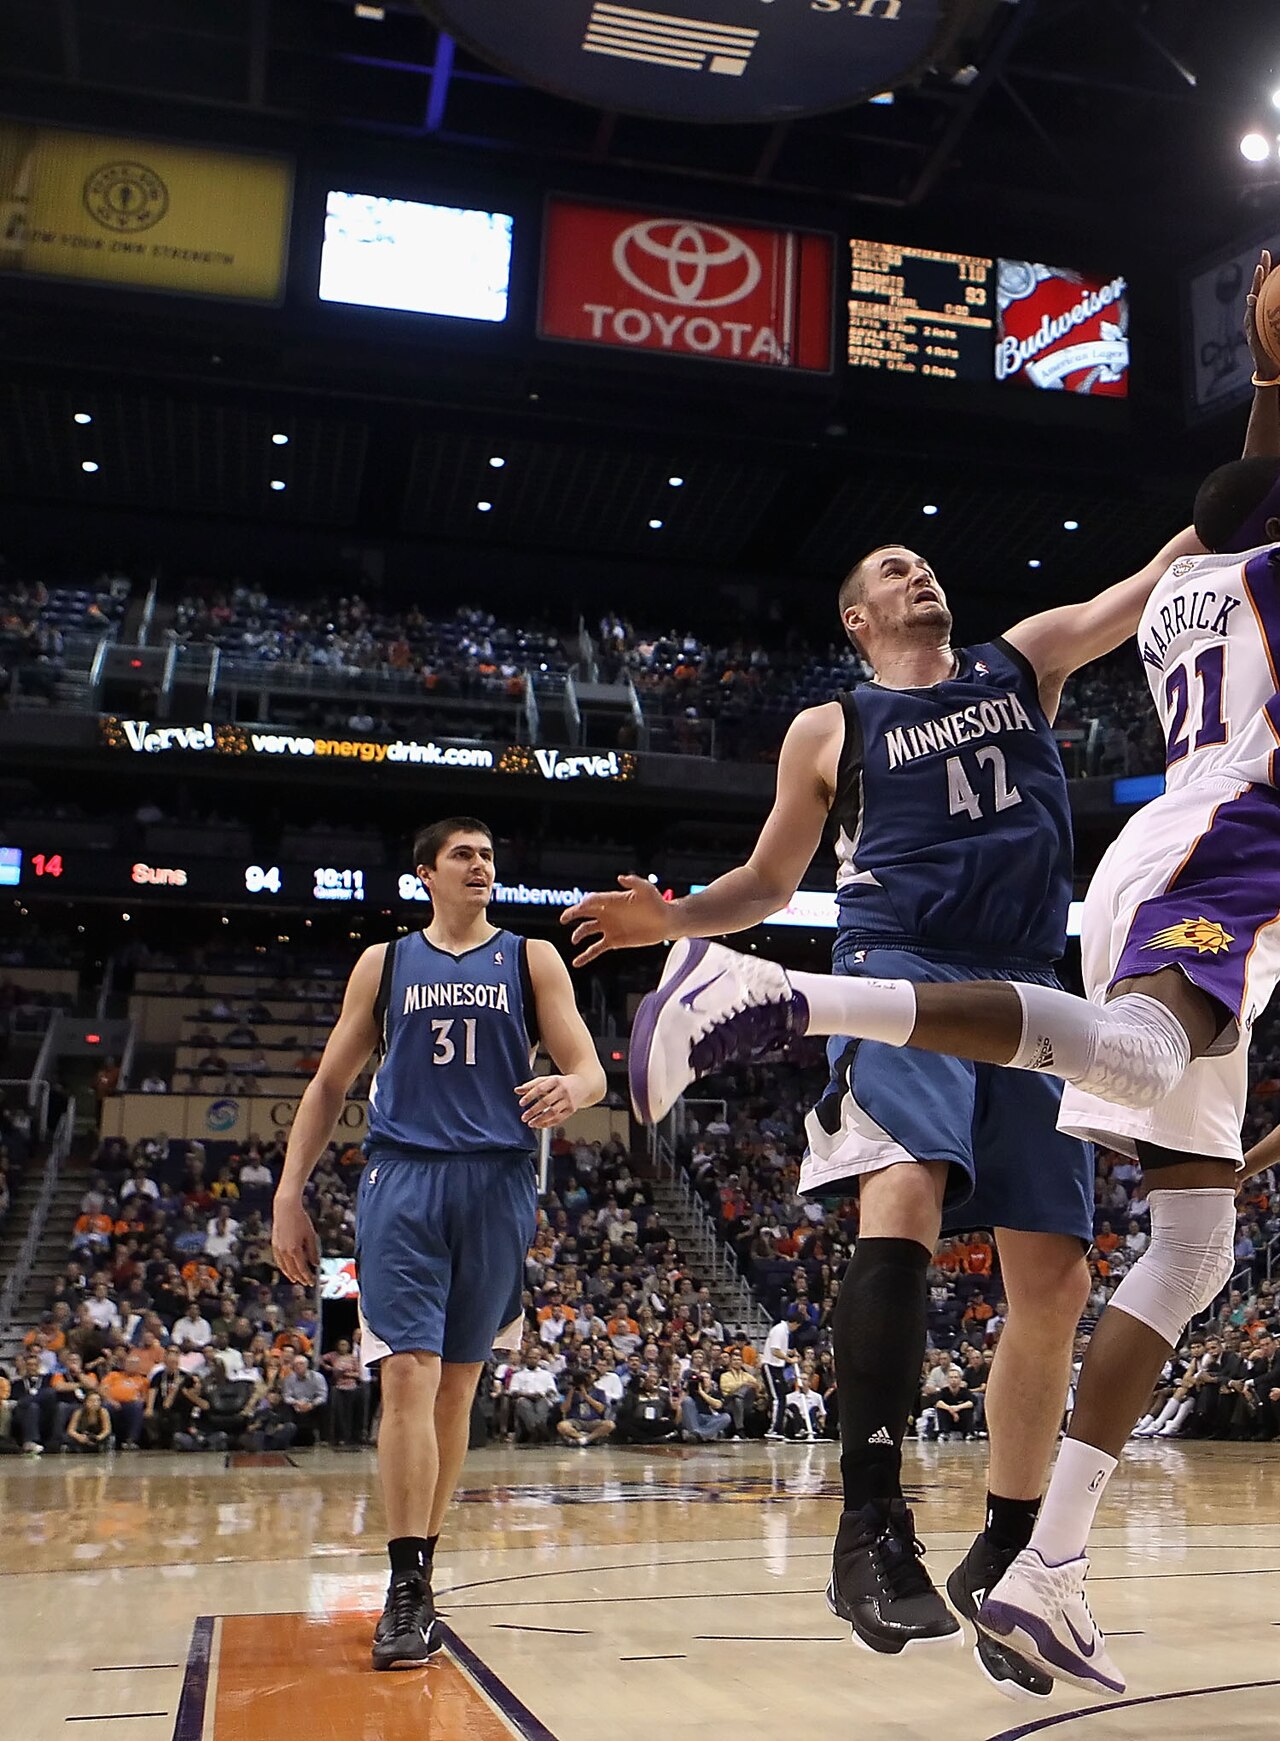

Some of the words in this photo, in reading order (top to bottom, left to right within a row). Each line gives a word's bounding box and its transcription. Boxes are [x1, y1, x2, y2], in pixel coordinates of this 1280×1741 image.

[583, 303, 785, 364] TOYOTA
[995, 276, 1127, 380] Budweiser
[1143, 591, 1241, 672] WARRICK
[884, 693, 1036, 770] MINNESOTA
[1166, 644, 1230, 769] 21
[122, 720, 215, 752] Verve!
[251, 734, 493, 768] verveenergydrink.com
[535, 748, 620, 780] Verve!
[946, 745, 1023, 821] 42
[32, 854, 63, 877] 14
[132, 863, 187, 886] Suns
[245, 865, 281, 893] 94
[314, 868, 363, 888] 10:11
[403, 983, 510, 1015] MINNESOTA
[431, 1019, 478, 1065] 31
[868, 1437, 894, 1446] adidas
